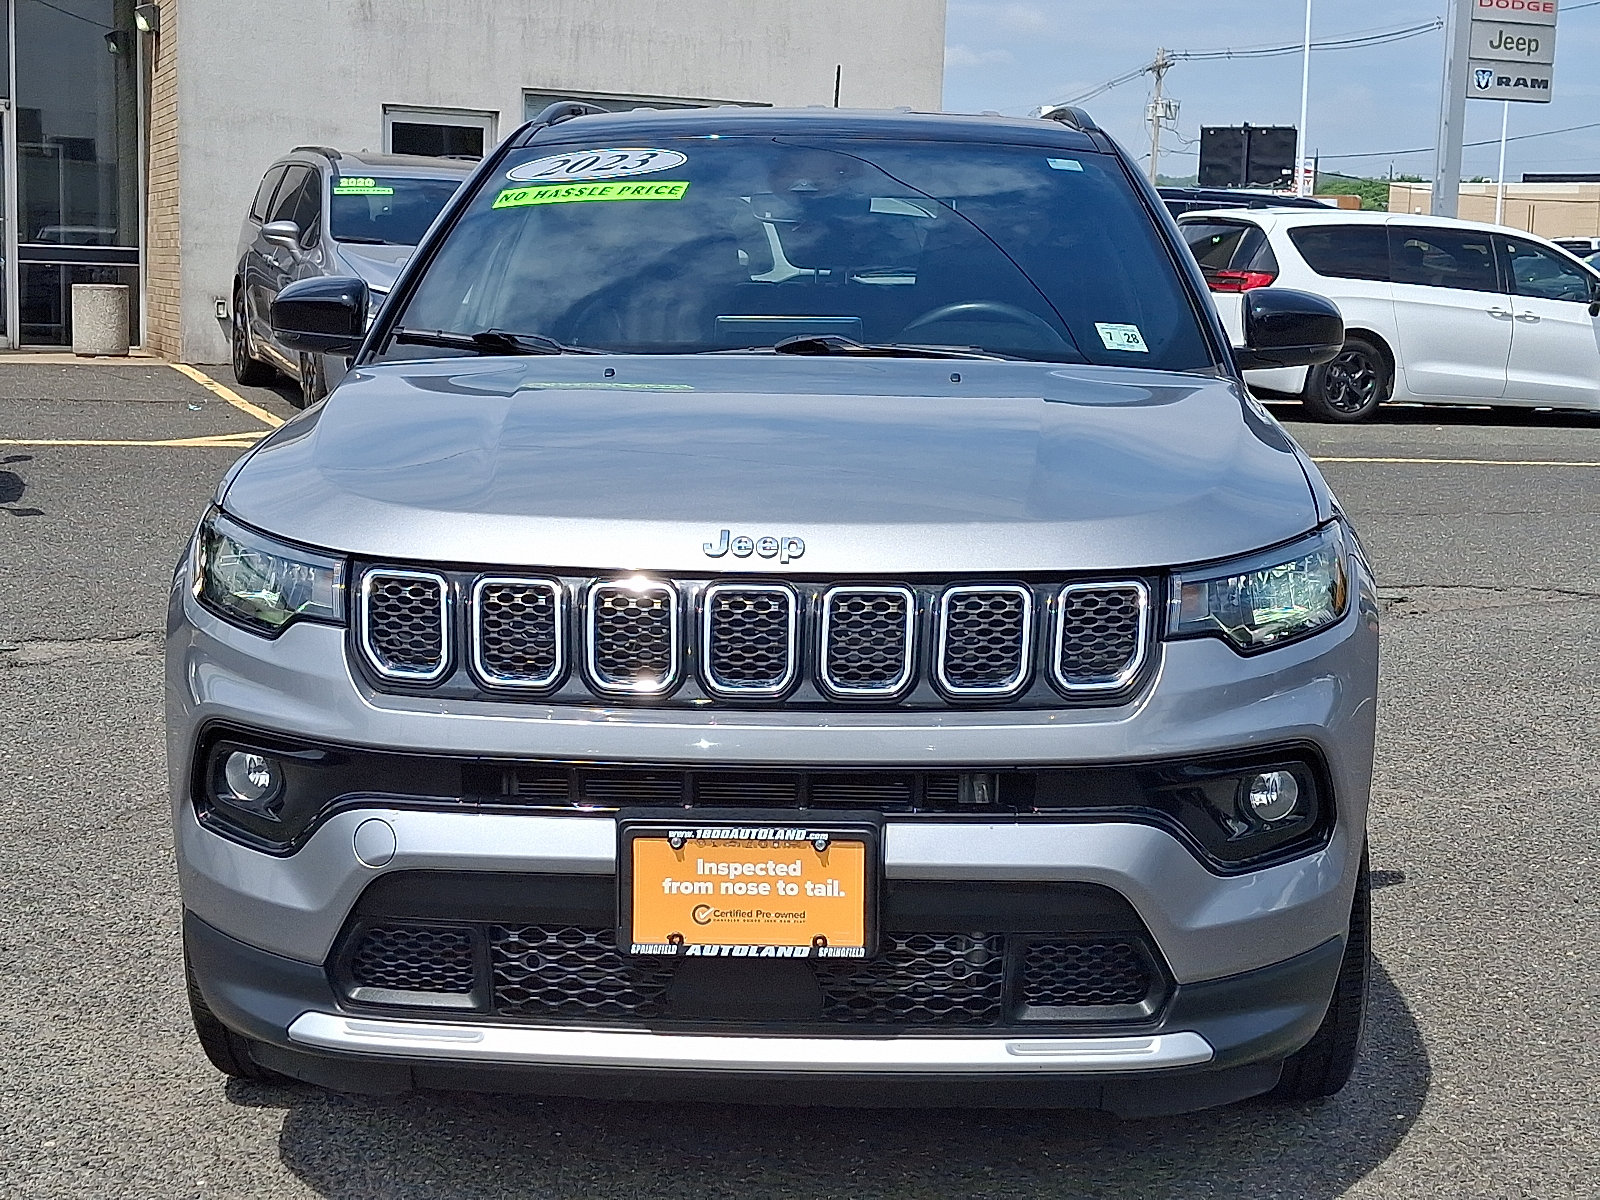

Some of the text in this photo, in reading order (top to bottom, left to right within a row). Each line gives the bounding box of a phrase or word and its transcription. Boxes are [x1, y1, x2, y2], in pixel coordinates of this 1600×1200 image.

[1479, 0, 1554, 13] DODGE
[1489, 29, 1539, 56] Jeep
[1496, 76, 1549, 89] RAM
[532, 152, 659, 178] 2023
[500, 185, 683, 202] NO HASSLE PRICE
[1105, 331, 1140, 344] 7 28
[703, 529, 805, 564] Jeep
[697, 858, 802, 879] Inspected
[662, 878, 846, 897] from nose to tail.
[713, 909, 753, 918] Certified
[630, 943, 865, 958] SPRINGFIELD AUTOLAND SPRINGFIELD
